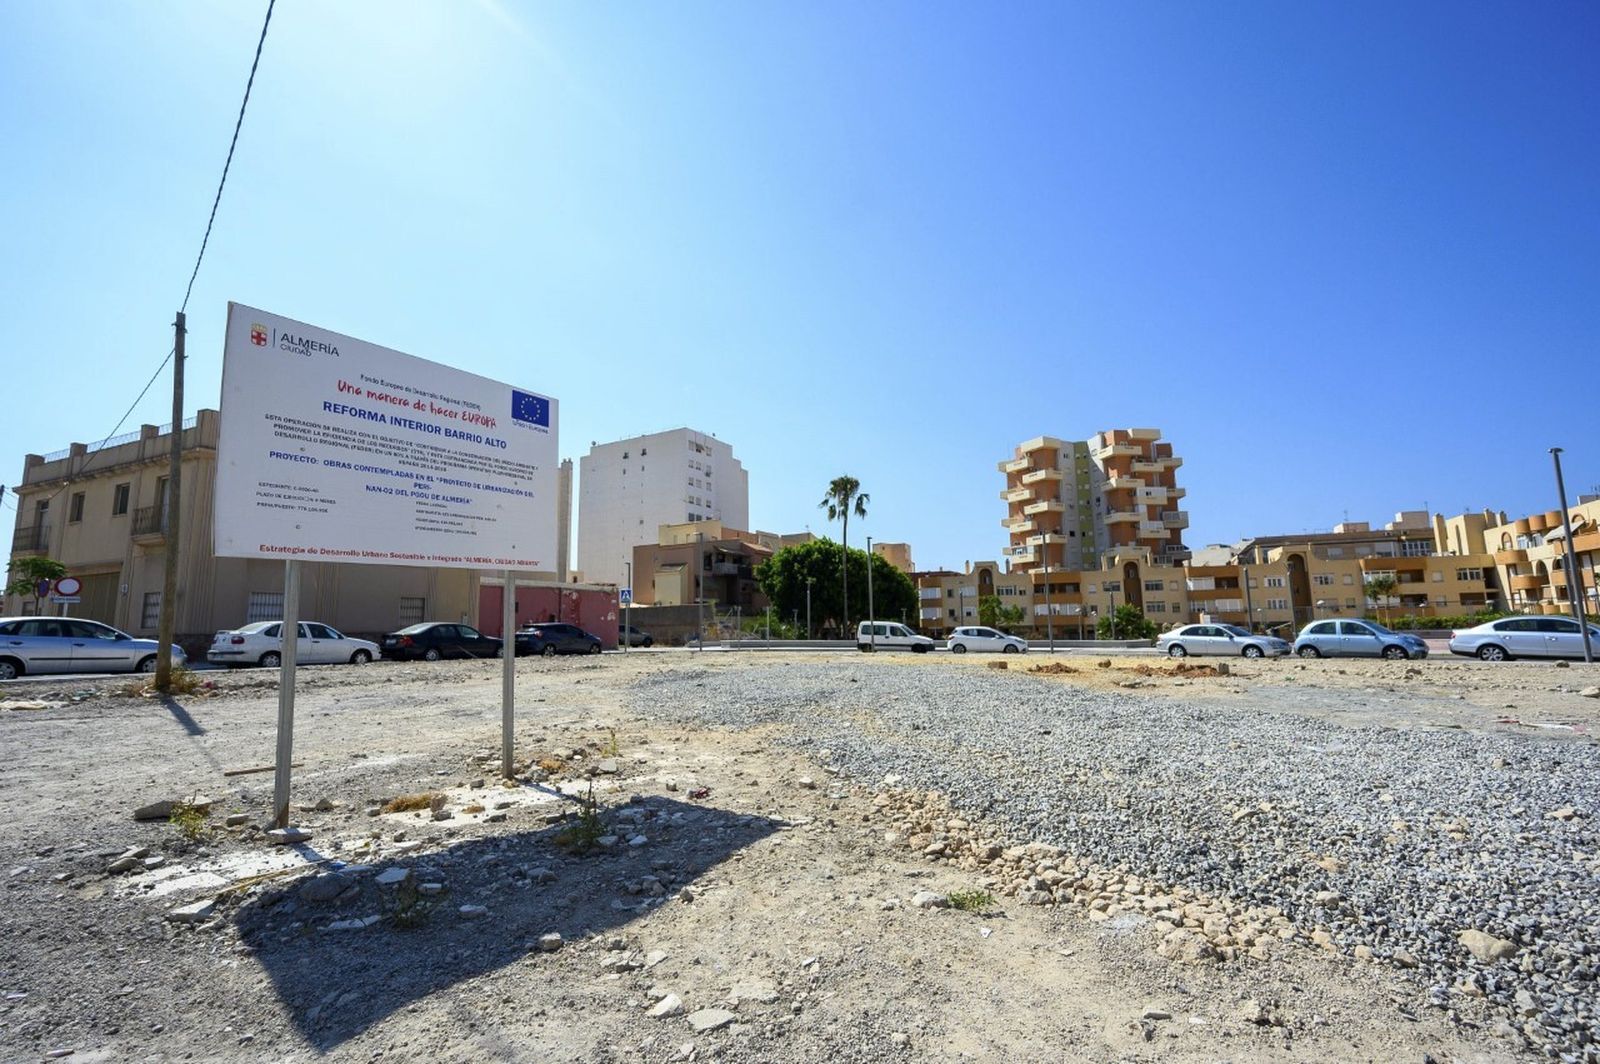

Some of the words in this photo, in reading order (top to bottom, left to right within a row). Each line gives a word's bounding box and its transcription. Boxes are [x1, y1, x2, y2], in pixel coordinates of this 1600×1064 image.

[280, 343, 312, 357] CIUDAD
[281, 333, 339, 357] ALMERÍA
[337, 380, 362, 396] Una
[366, 390, 409, 407] manera
[413, 399, 426, 412] de
[430, 401, 458, 419] hacer
[461, 411, 496, 428] EUROPA
[323, 401, 387, 423] REFORMA
[390, 416, 441, 435] INTERIOR
[444, 428, 482, 444] BARRIO
[484, 437, 507, 449] ALTO
[269, 451, 318, 464] PROYECTO:
[323, 459, 352, 470] OBRAS
[353, 464, 414, 479] CONTEMPLADAS
[415, 473, 425, 481] EN
[472, 482, 481, 490] DE
[365, 485, 393, 495] NAN-02
[395, 488, 409, 497] DEL
[430, 493, 441, 501] DE
[259, 544, 306, 555] Estrategia
[307, 547, 318, 555] de
[319, 548, 361, 557] Desarrollo
[361, 550, 389, 558] Urbano
[389, 552, 425, 560] Sostenible
